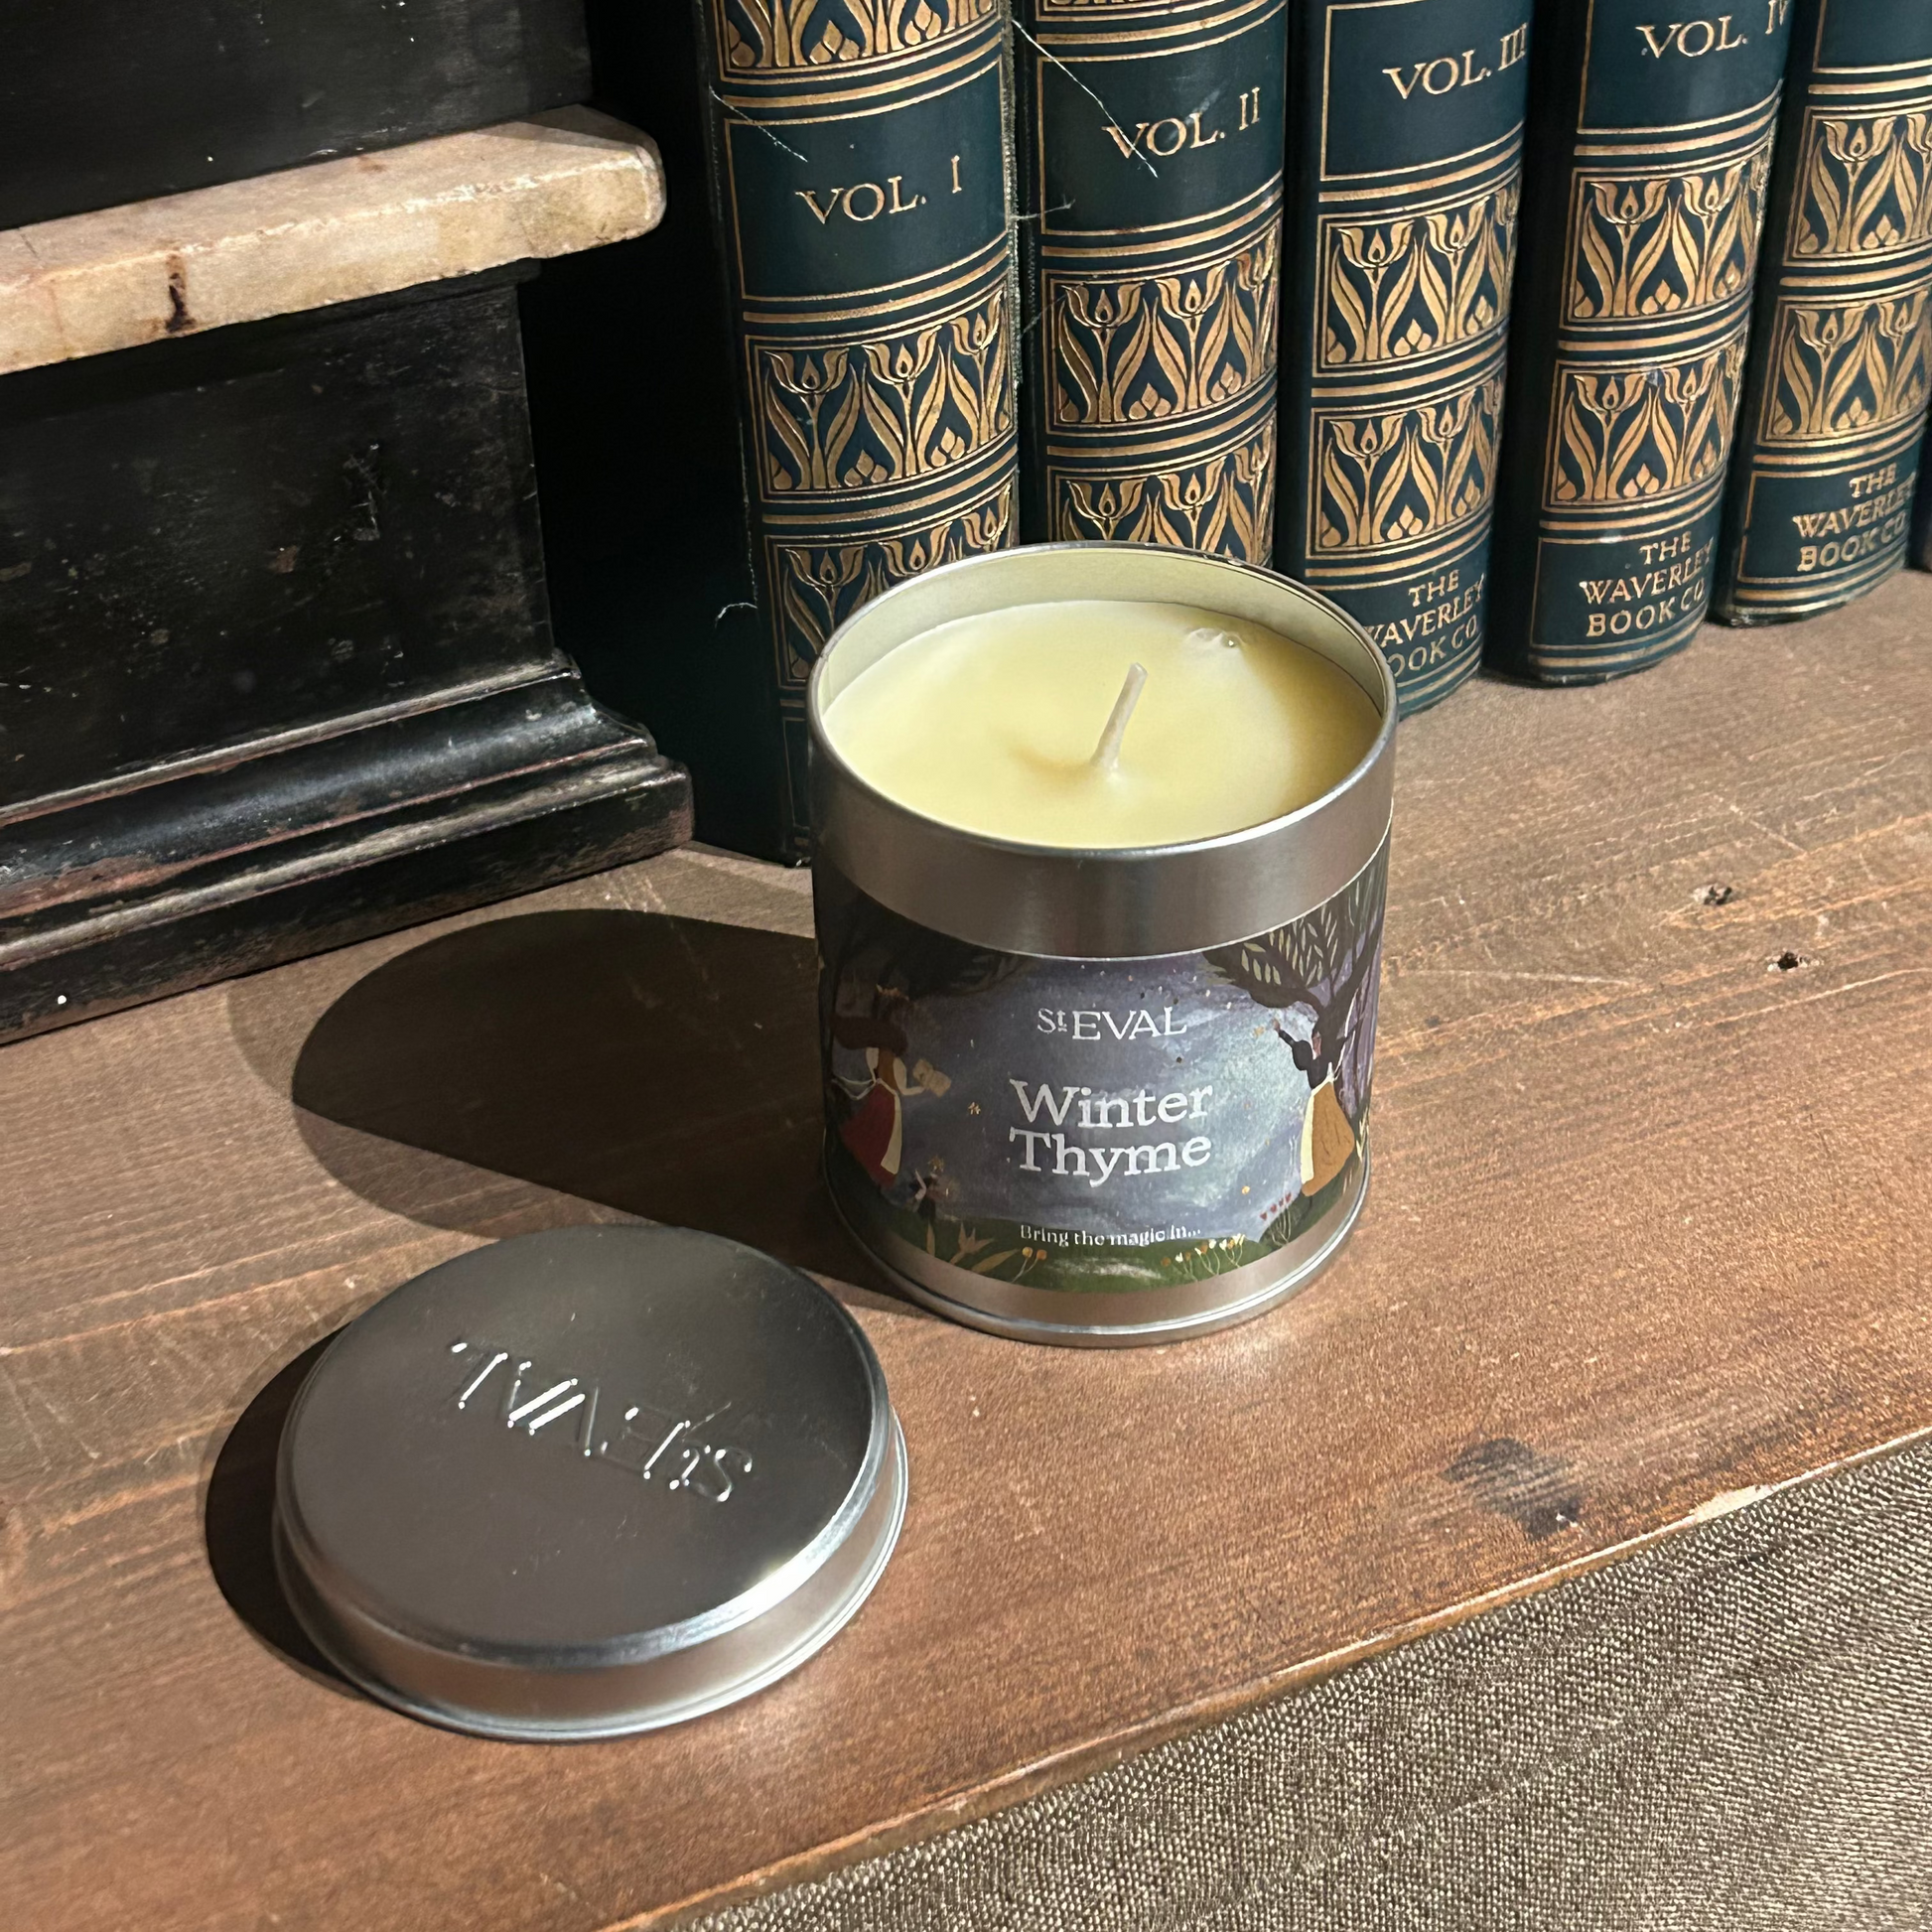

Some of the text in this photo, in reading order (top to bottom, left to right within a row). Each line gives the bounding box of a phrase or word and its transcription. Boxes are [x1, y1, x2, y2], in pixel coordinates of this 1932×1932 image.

[1634, 14, 1748, 59] VOL.
[1381, 22, 1529, 100] VOL. III
[1102, 86, 1261, 160] VOL. II
[795, 155, 961, 224] VOL. I
[1849, 463, 1897, 498] THE
[1638, 530, 1692, 565] THE
[1797, 526, 1881, 572] BOOK
[1408, 569, 1460, 608] THE
[1579, 536, 1715, 605] WAVERLEY
[1586, 596, 1677, 637] BOOK
[1386, 635, 1448, 678] OOK
[1008, 1077, 1214, 1129] Winter
[1008, 1126, 1213, 1187] Thyme
[1020, 1224, 1069, 1247] Bring
[1074, 1229, 1105, 1246] the
[1107, 1227, 1167, 1247] magic
